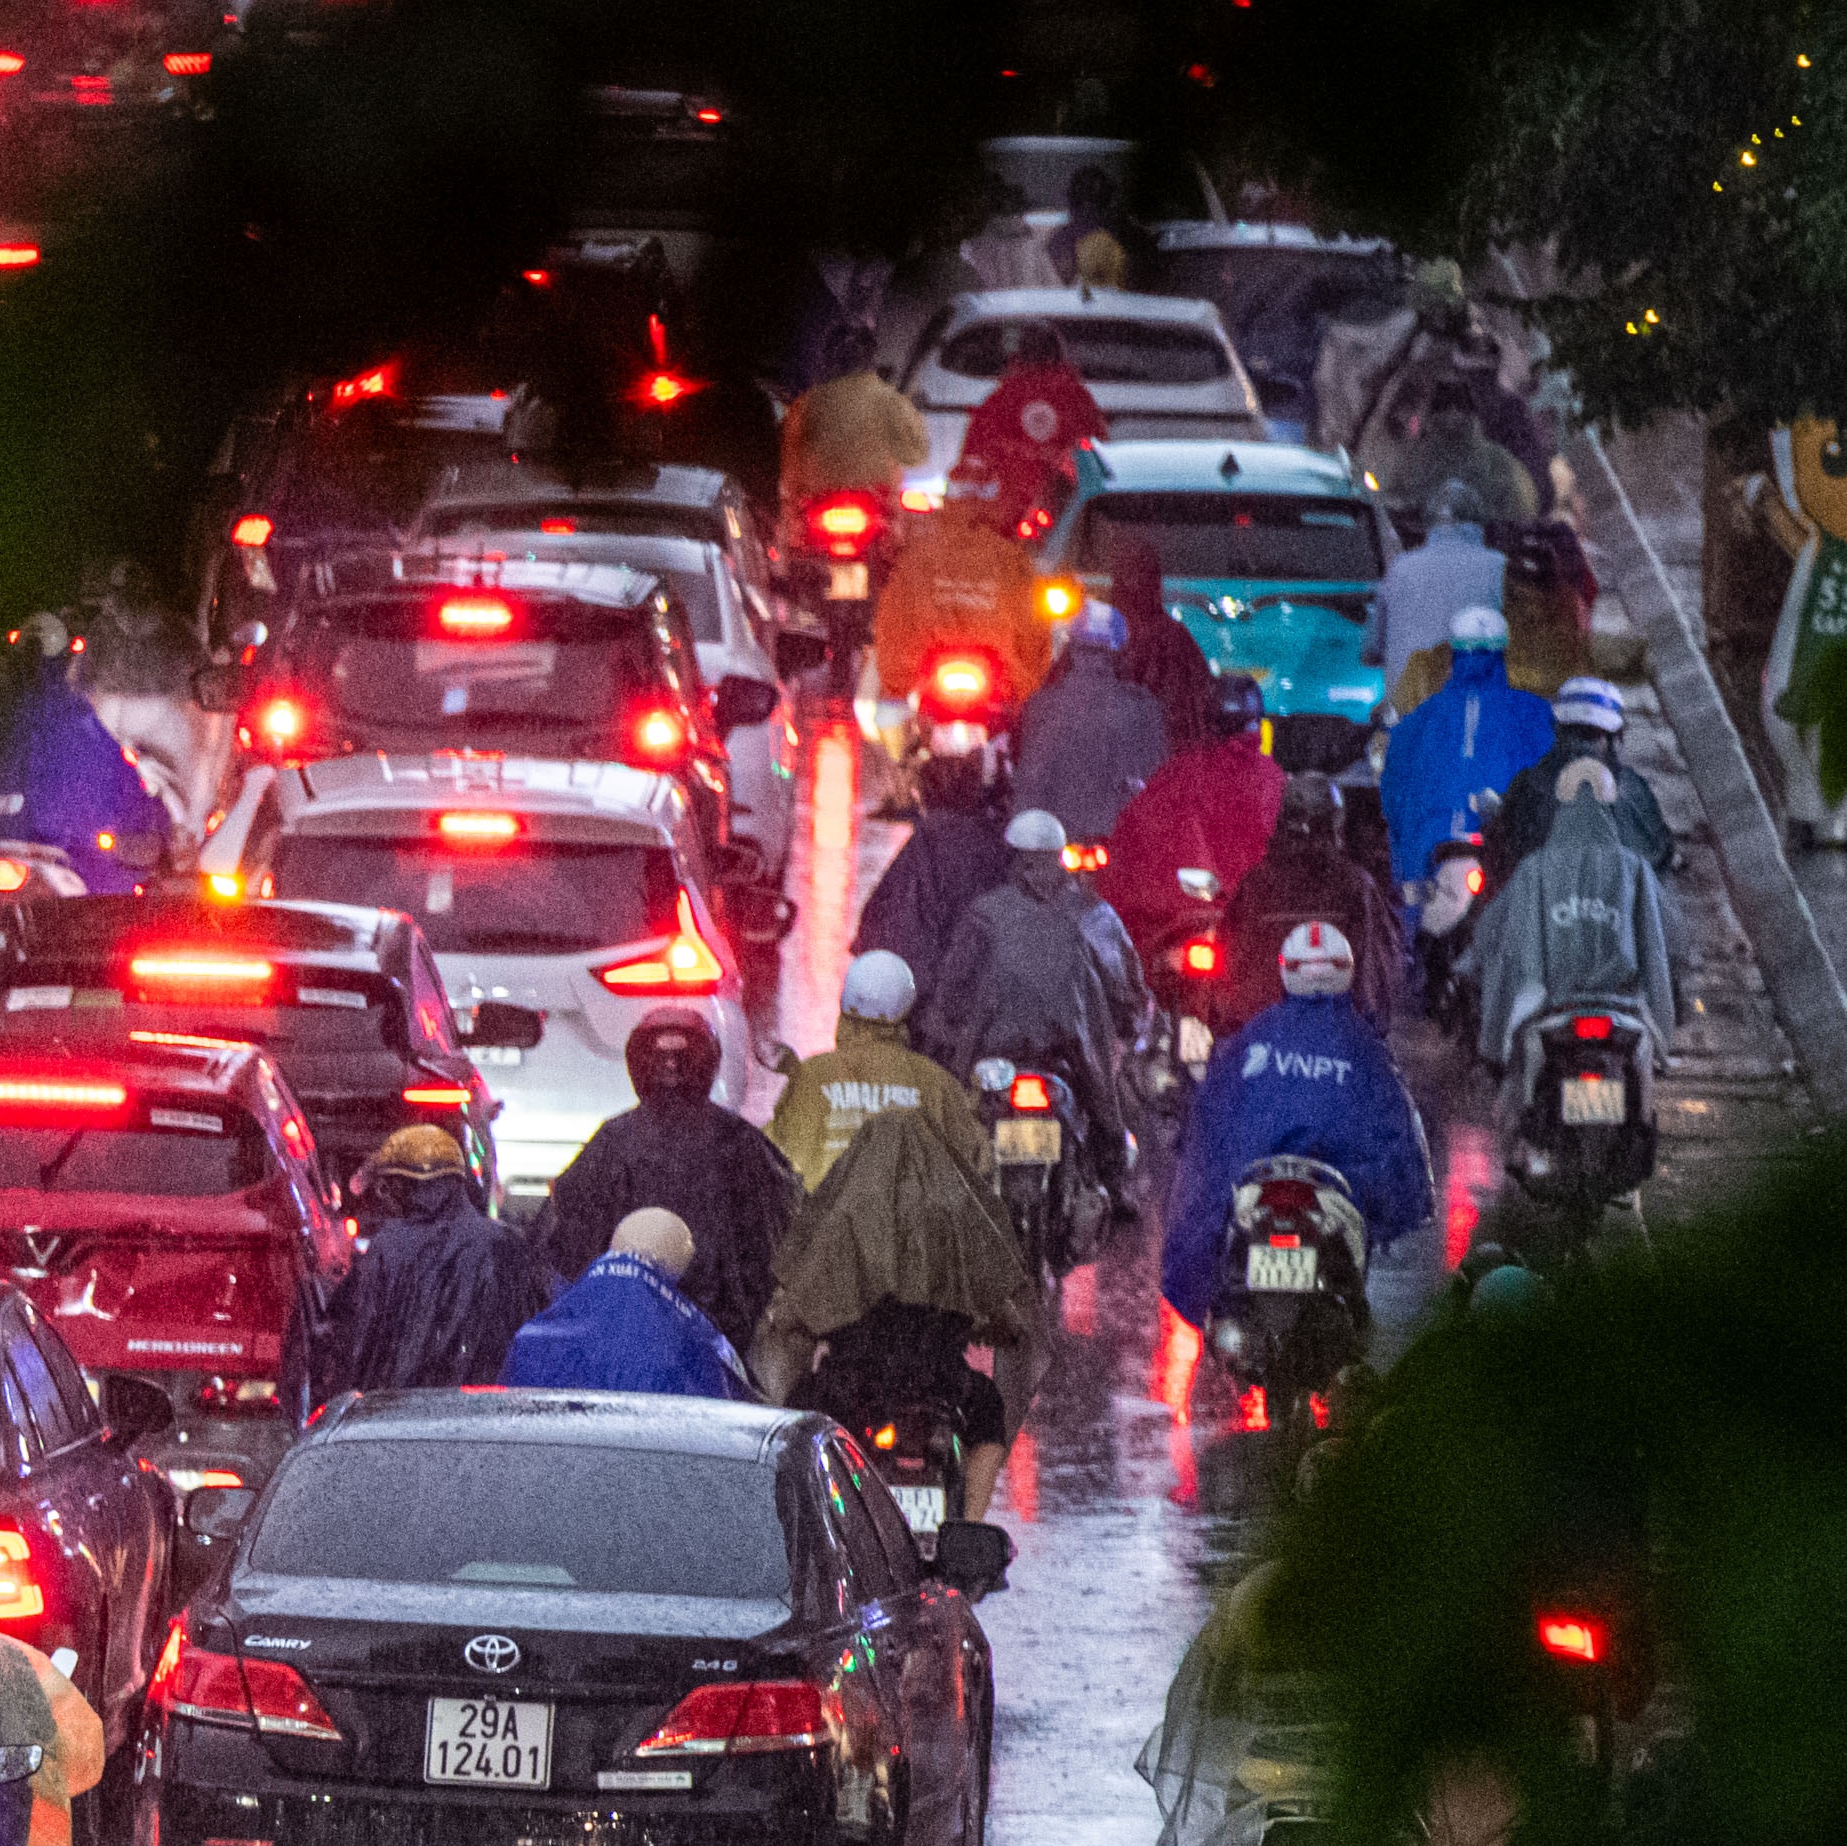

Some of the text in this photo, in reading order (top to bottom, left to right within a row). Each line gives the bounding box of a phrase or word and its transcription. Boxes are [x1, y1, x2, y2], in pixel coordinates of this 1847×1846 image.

[1274, 1050, 1352, 1085] VNPT
[458, 1703, 519, 1741] 29A
[438, 1741, 539, 1780] 124.01
